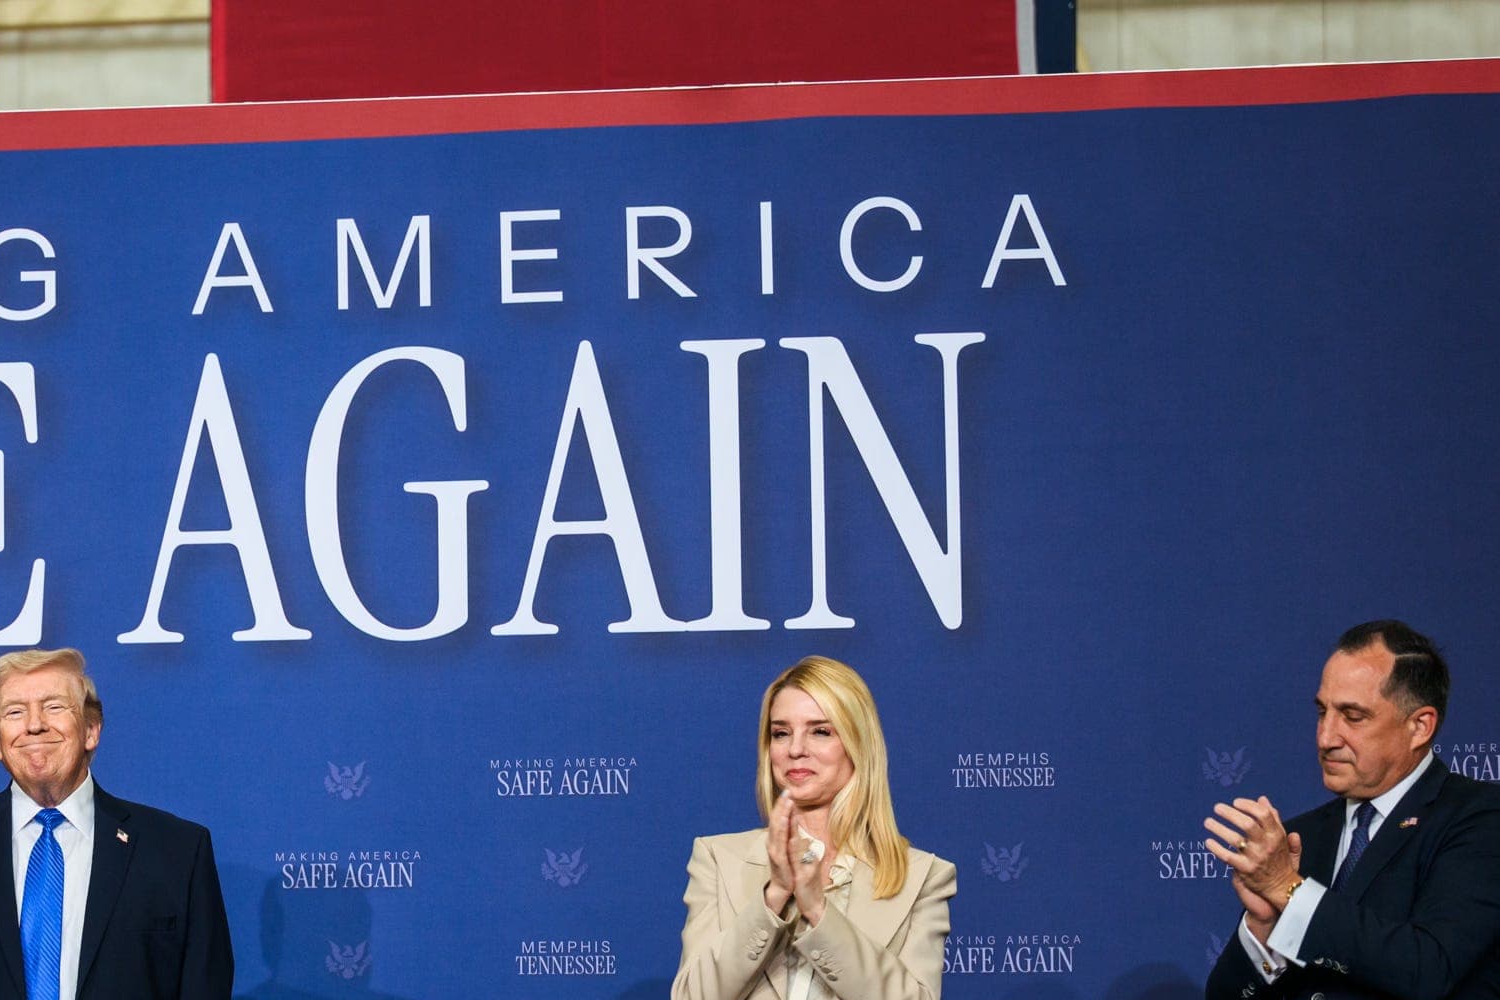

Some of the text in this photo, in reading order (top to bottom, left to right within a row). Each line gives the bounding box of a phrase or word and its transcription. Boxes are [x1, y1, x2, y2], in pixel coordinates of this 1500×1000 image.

[192, 194, 1066, 314] AMERICA
[117, 332, 985, 643] AGAIN
[1451, 741, 1500, 754] AMER
[490, 757, 637, 769] MAKING AMERICA
[958, 752, 1049, 767] MEMPHIS
[497, 768, 630, 797] SAFE AGAIN
[951, 767, 1055, 788] TENNESSEE
[275, 850, 421, 862] MAKING AMERICA
[1151, 840, 1206, 852] MAKIN
[282, 861, 414, 889] SAFE AGAIN
[1158, 850, 1218, 880] SAFE
[521, 940, 611, 954] MEMPHIS
[944, 934, 1081, 945] AKING AMERICA
[515, 955, 616, 975] TENNESSEE
[1000, 946, 1074, 973] AGAIN
